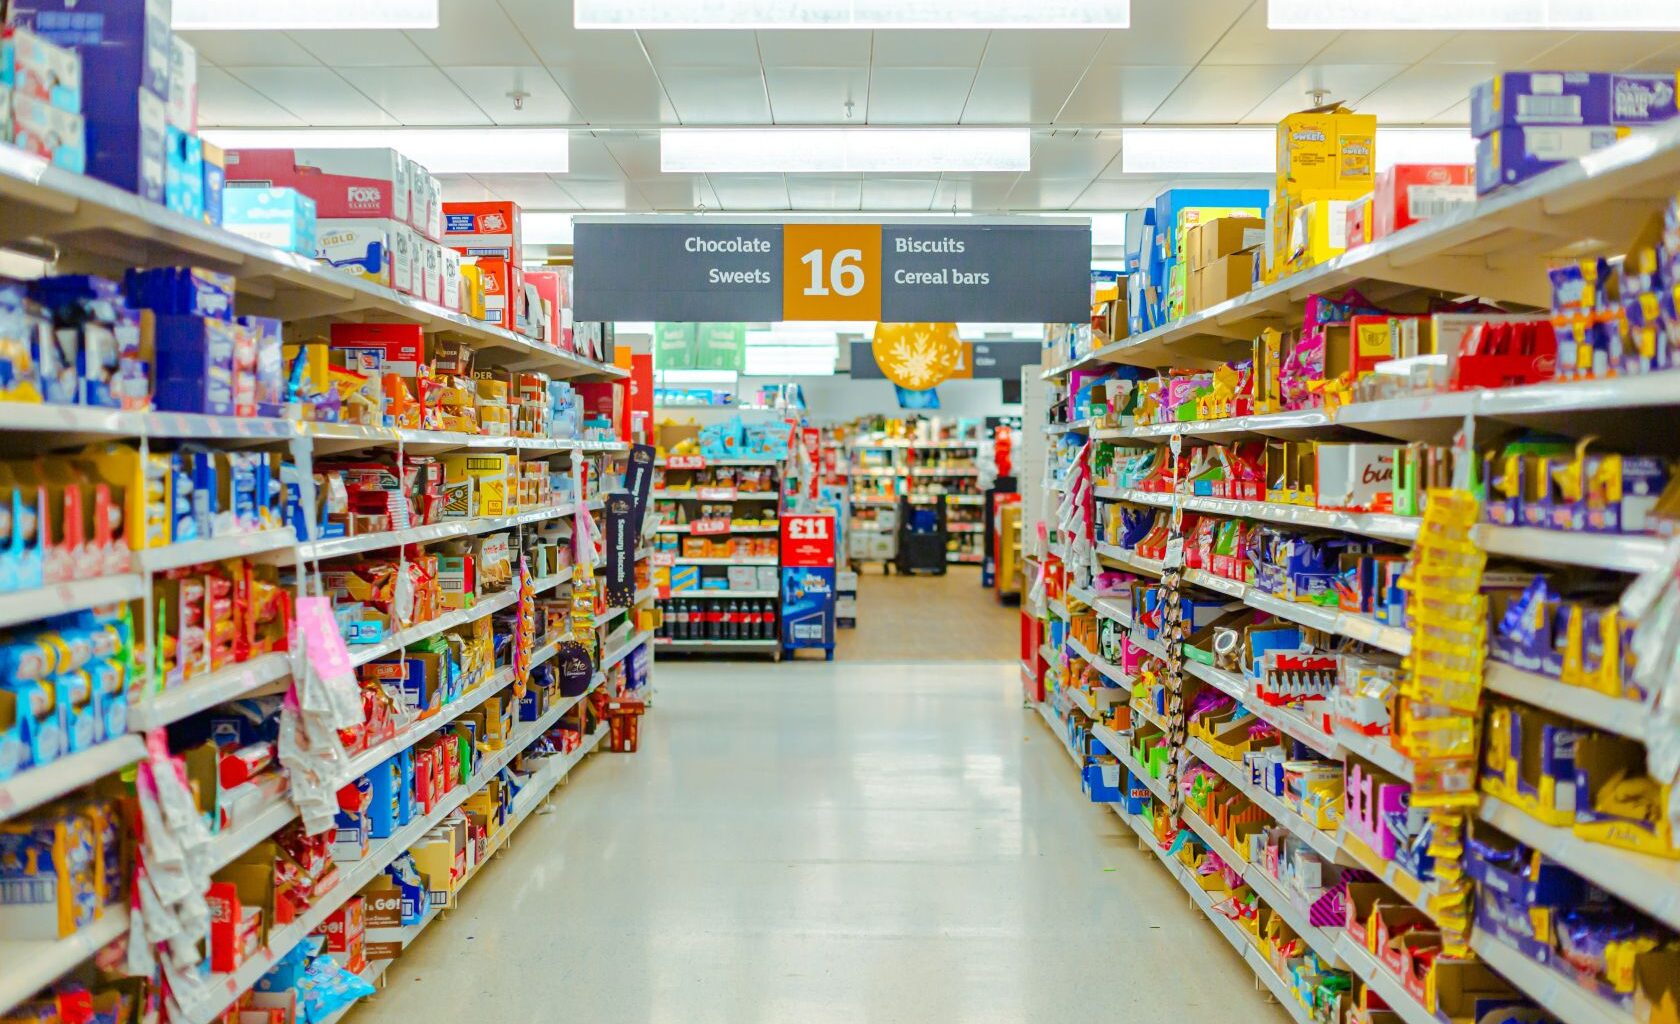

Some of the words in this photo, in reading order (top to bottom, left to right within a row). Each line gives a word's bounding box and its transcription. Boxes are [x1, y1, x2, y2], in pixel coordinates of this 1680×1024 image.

[1615, 104, 1649, 118] MILK
[322, 233, 354, 247] GOLD
[684, 236, 771, 253] Chocolate
[895, 236, 965, 253] Biscuits
[709, 268, 771, 284] Sweets
[800, 248, 865, 297] 16
[894, 268, 948, 285] Cereal
[952, 268, 990, 285] bars
[473, 371, 492, 380] DER
[616, 519, 625, 550] Savoury
[788, 518, 829, 539] £11
[617, 551, 625, 583] biscuits
[1131, 789, 1152, 798] HAR
[375, 898, 400, 911] GO!
[318, 921, 344, 934] GO!
